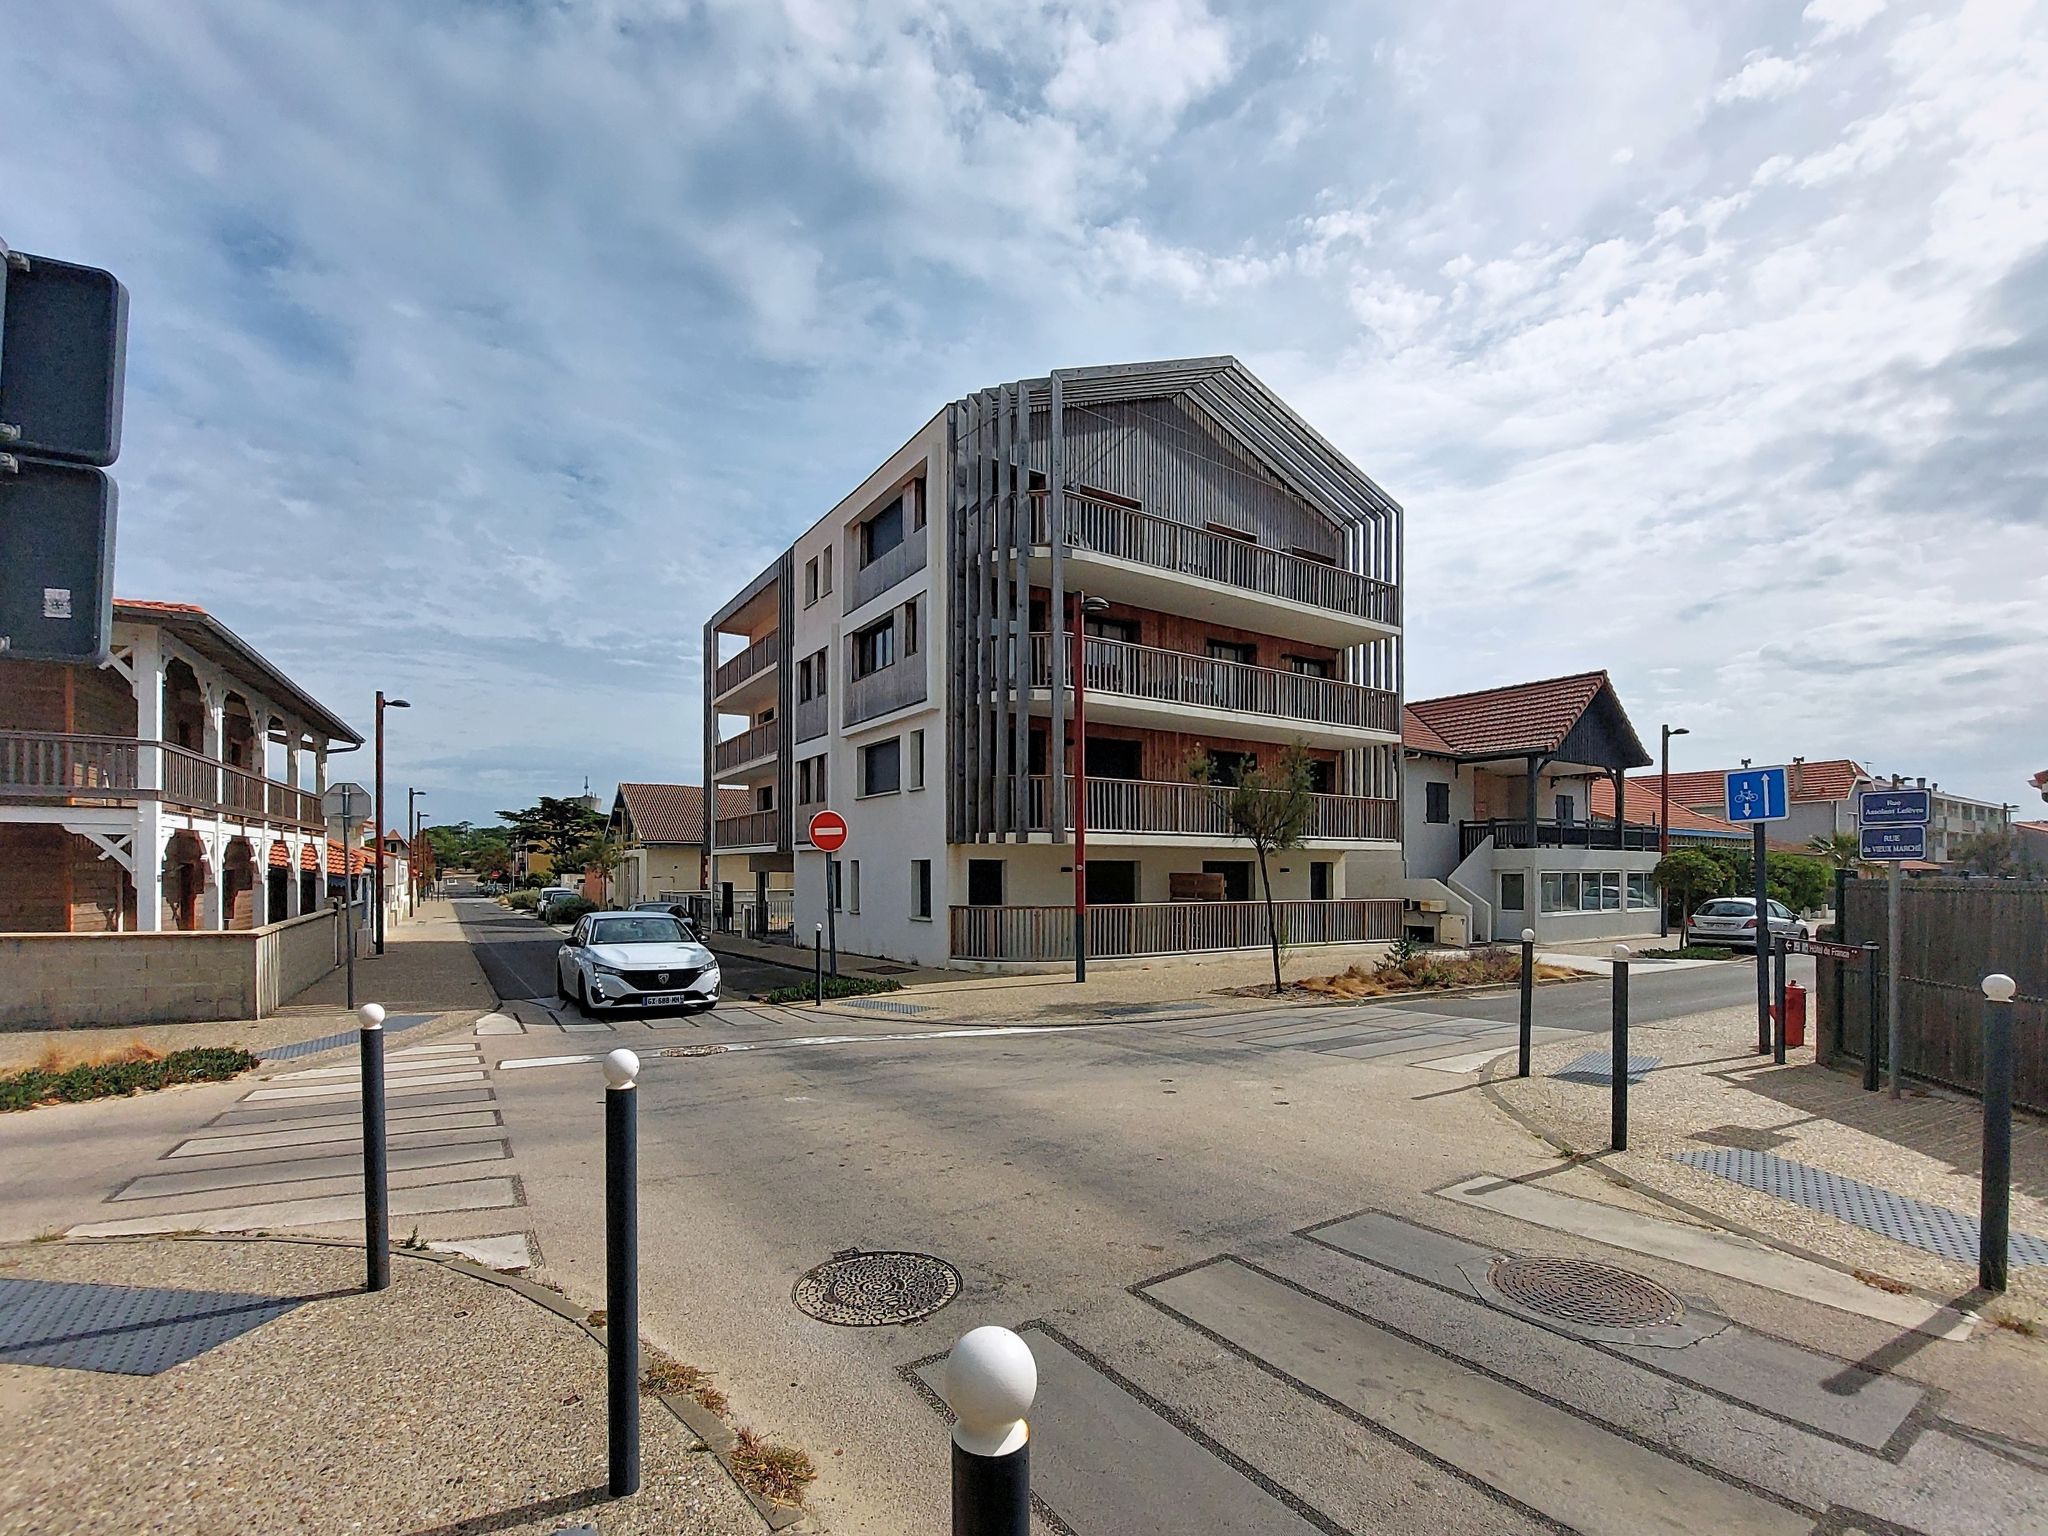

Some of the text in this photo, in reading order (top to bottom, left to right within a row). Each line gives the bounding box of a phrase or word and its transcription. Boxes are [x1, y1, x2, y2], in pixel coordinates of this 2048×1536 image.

[1883, 834, 1901, 842] RUE
[1872, 845, 1892, 853] VIEUX
[1893, 844, 1922, 852] MARCHÉ
[1809, 944, 1824, 954] Hôtel
[1831, 947, 1850, 959] France
